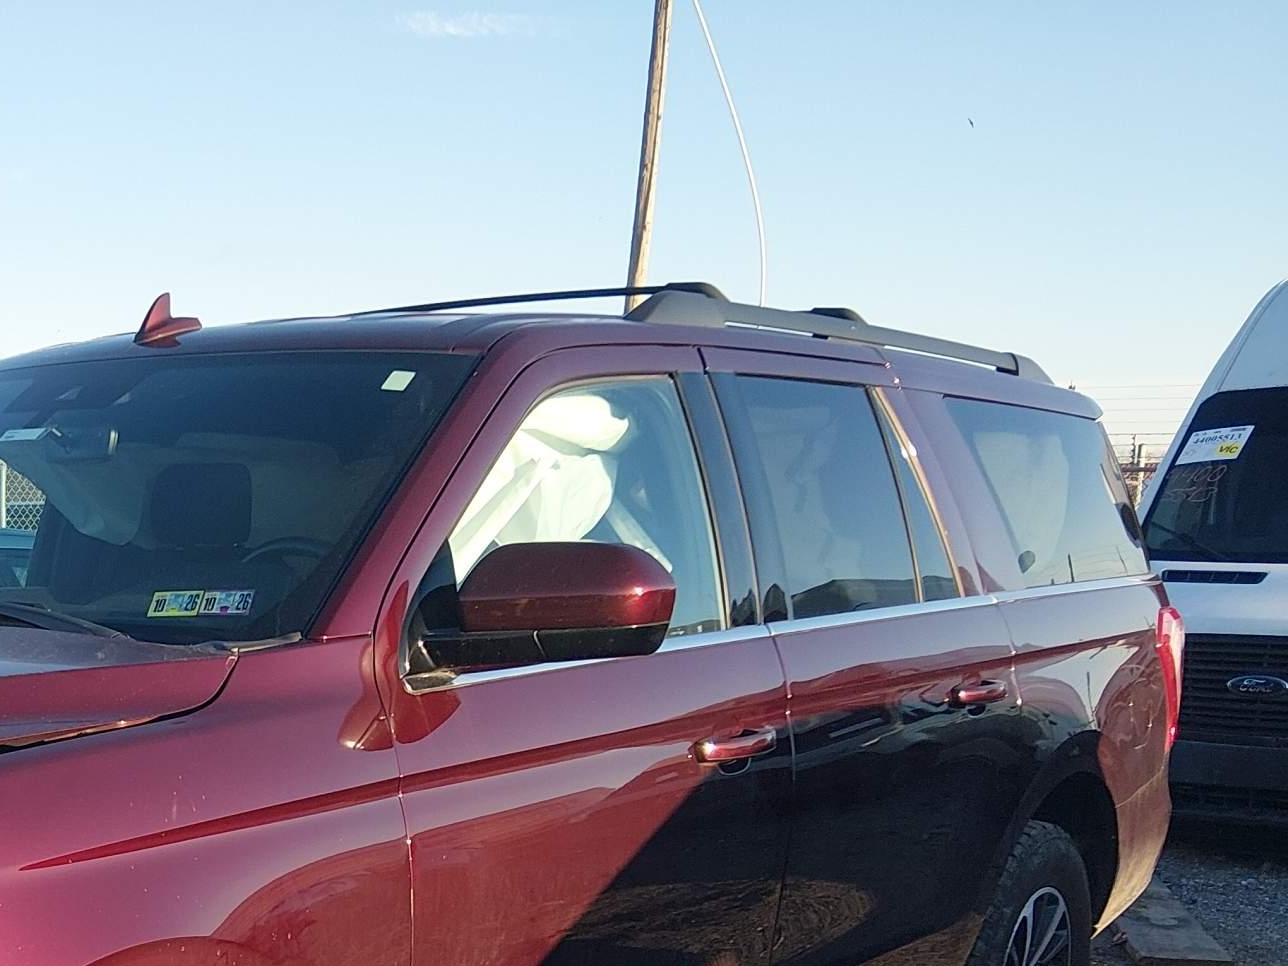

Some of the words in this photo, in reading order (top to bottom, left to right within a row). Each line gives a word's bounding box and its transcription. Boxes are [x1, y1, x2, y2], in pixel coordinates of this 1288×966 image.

[153, 598, 167, 613] 10
[184, 593, 201, 612] 26
[203, 596, 217, 612] 10
[235, 592, 252, 611] 26
